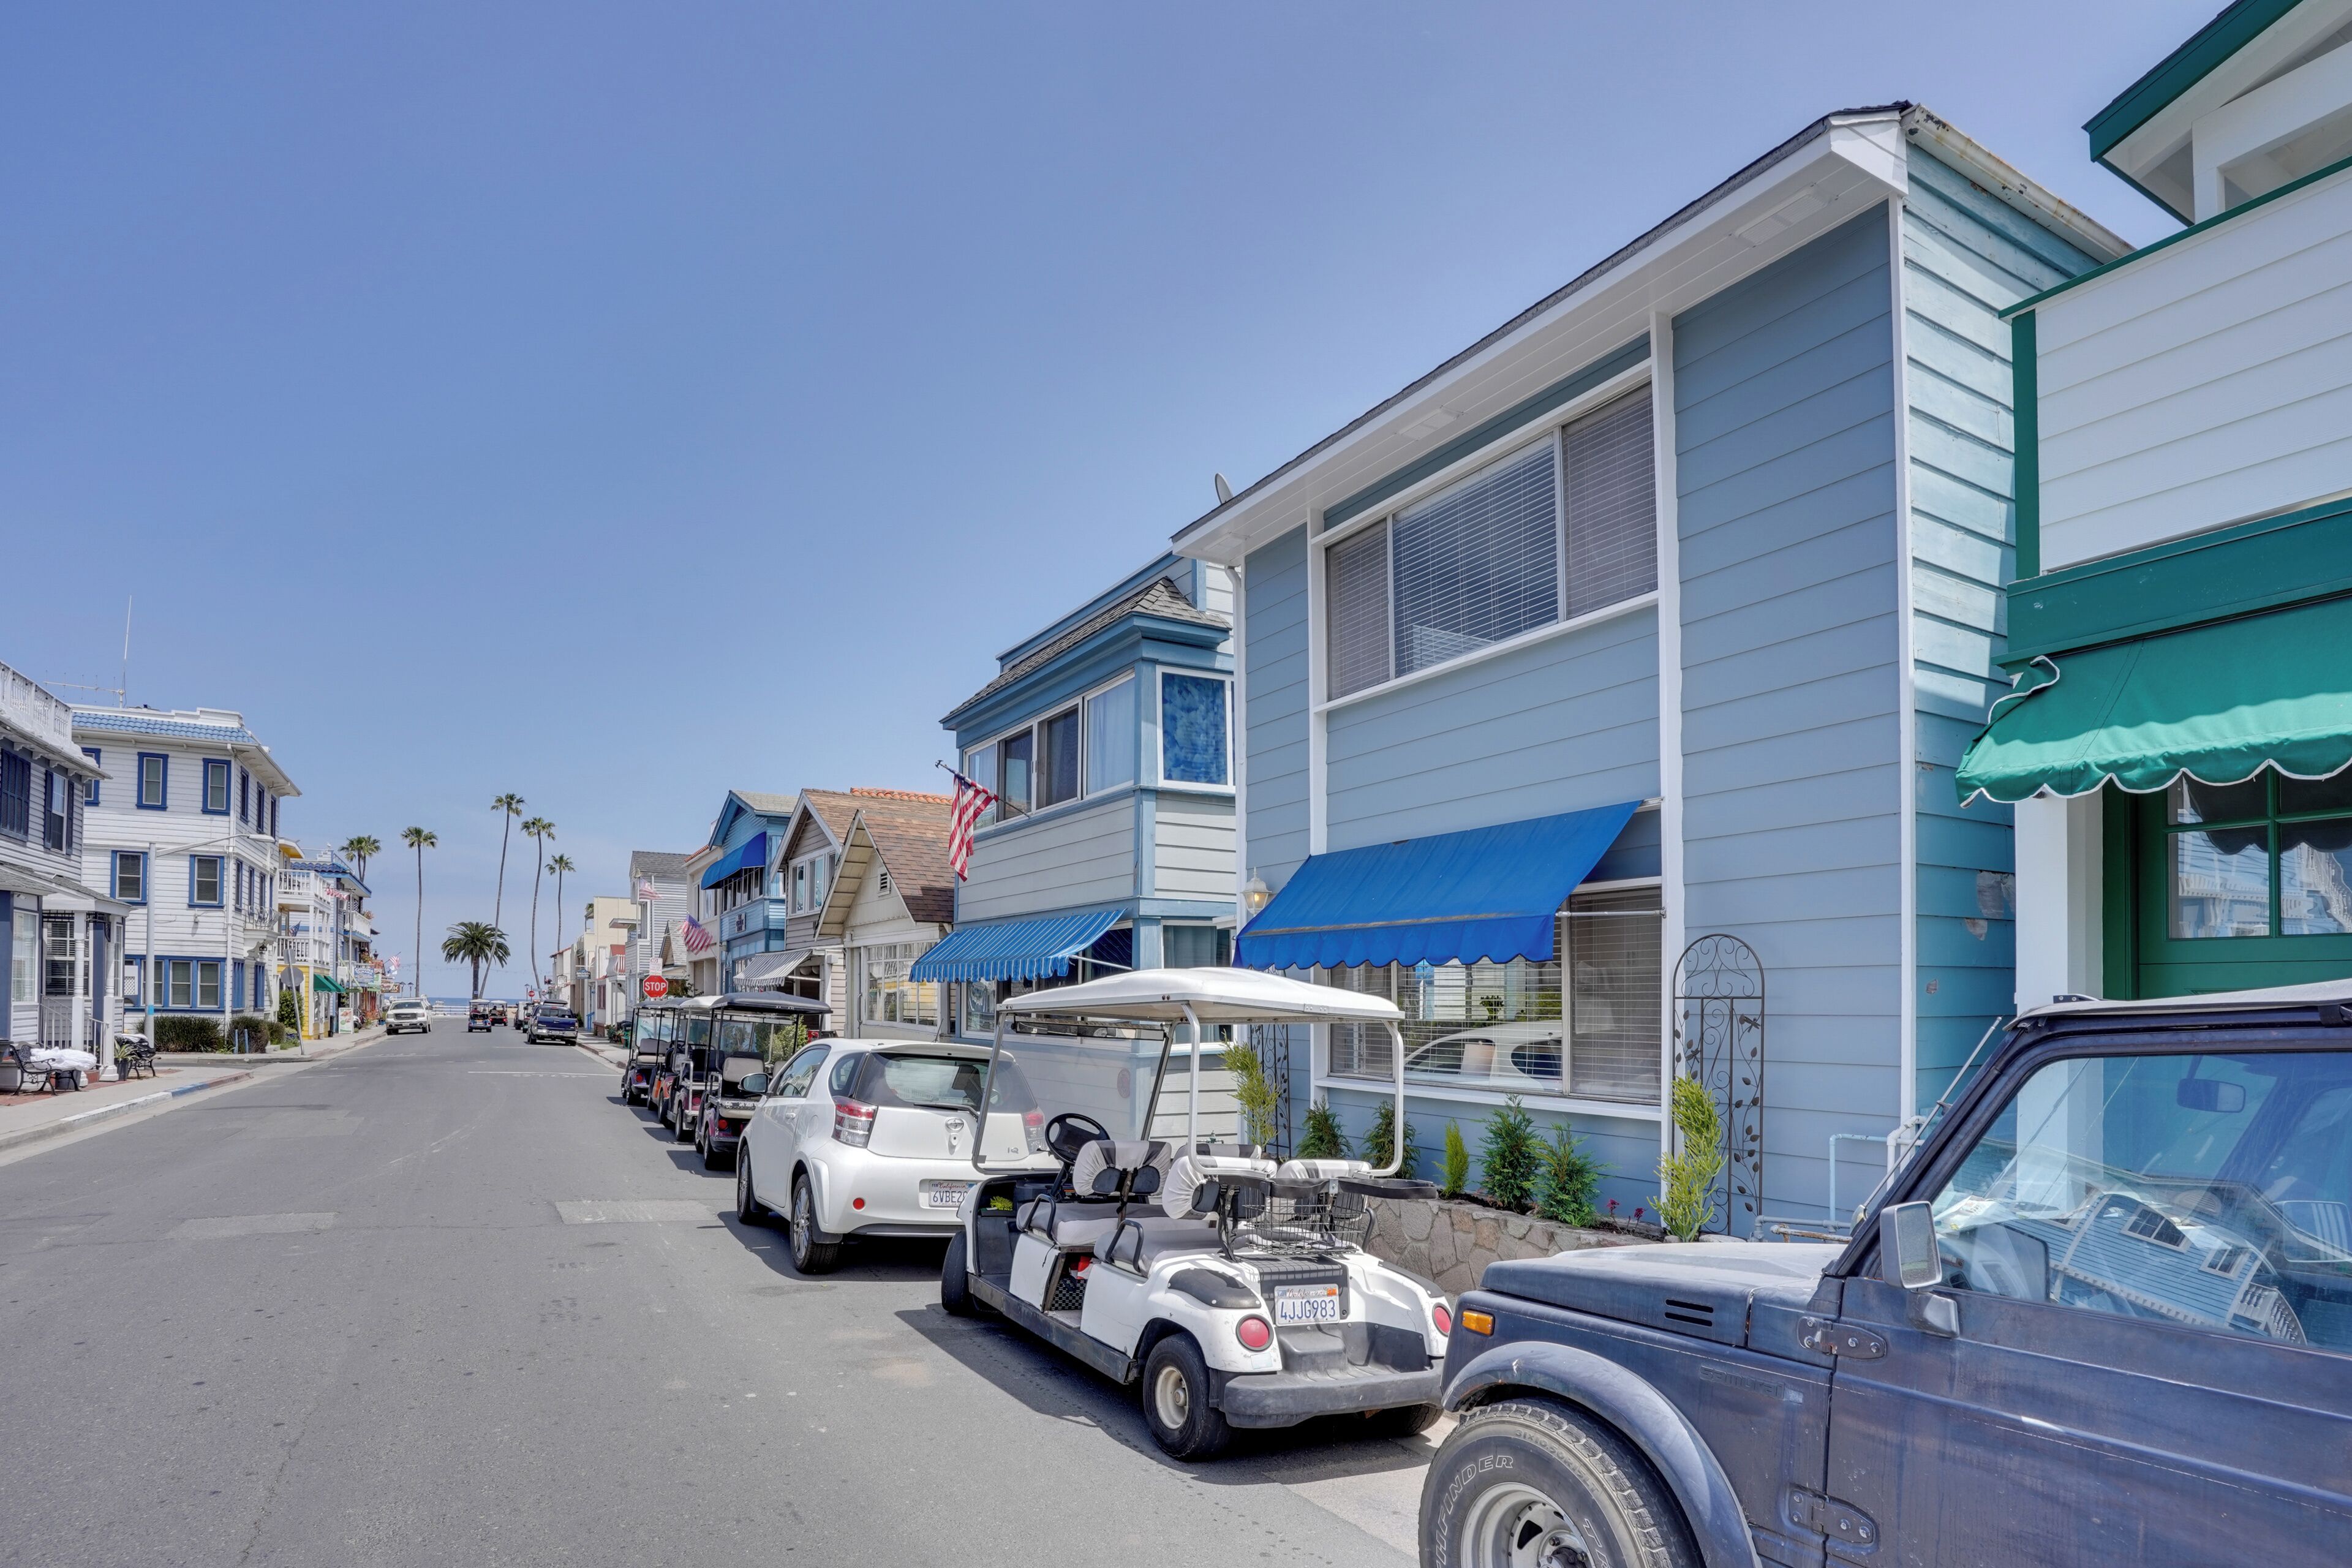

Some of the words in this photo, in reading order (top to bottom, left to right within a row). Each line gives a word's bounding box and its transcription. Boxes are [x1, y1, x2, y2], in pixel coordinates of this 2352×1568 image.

[644, 982, 666, 991] STOP
[1280, 1299, 1336, 1321] 4JJG983
[1435, 1455, 1514, 1568] HFINDER
